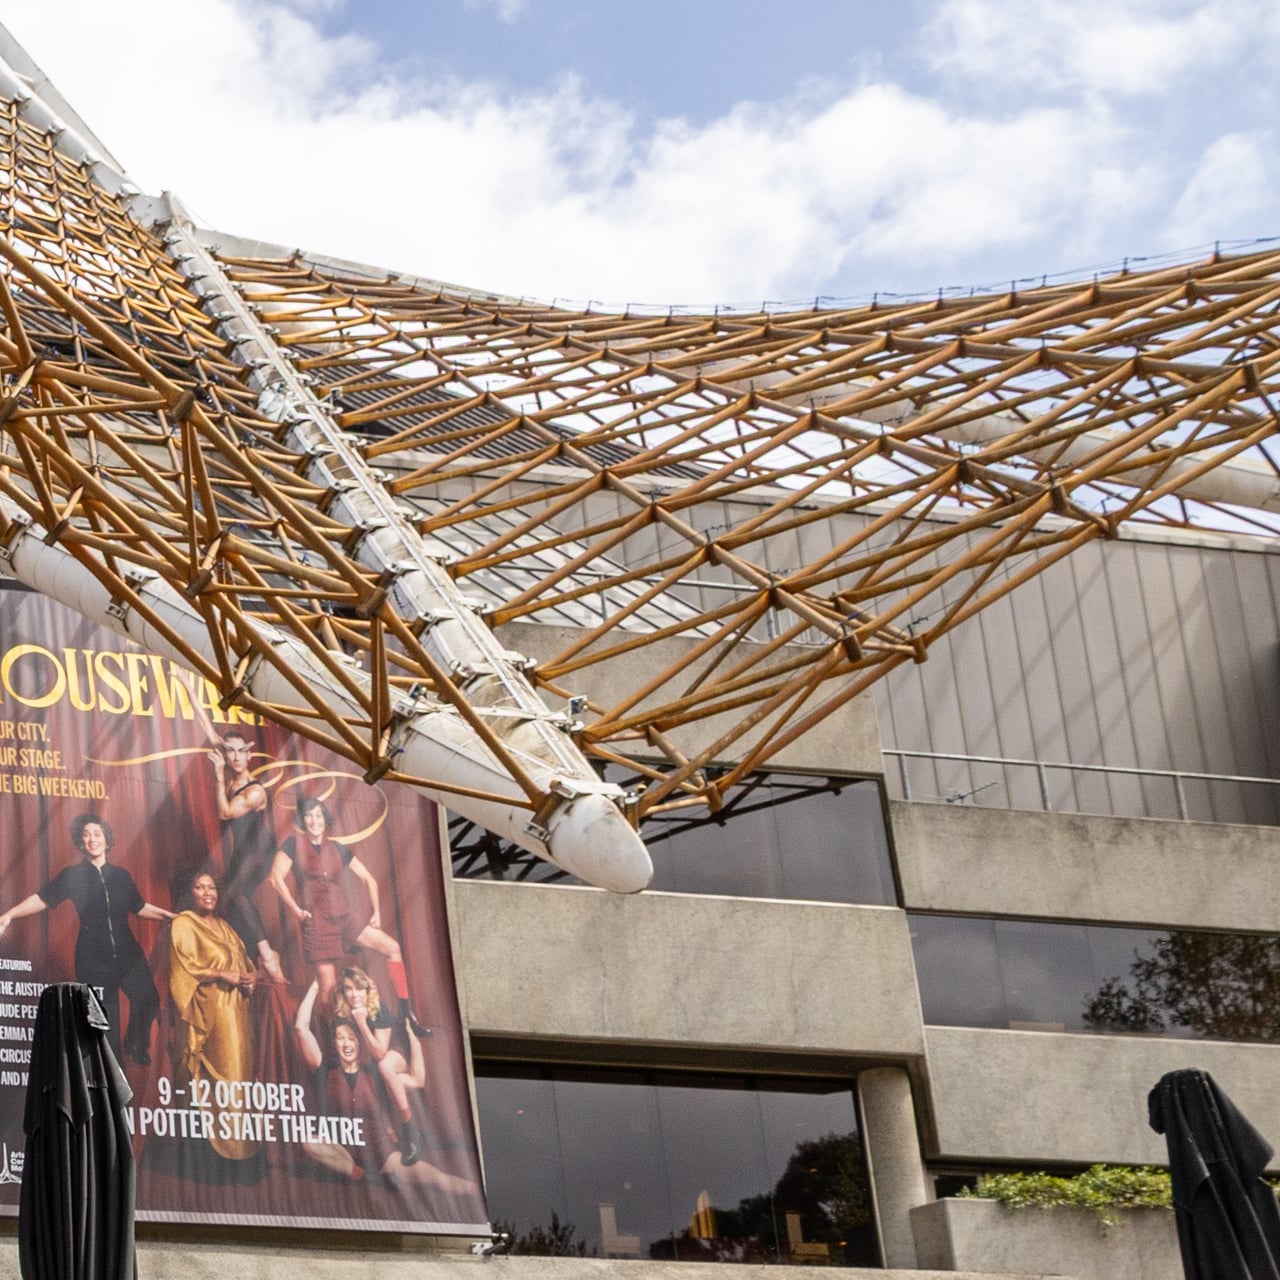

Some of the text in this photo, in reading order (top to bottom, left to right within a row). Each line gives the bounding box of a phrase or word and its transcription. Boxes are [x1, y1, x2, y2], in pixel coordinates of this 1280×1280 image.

[18, 721, 51, 743] CITY.
[20, 748, 67, 771] STAGE.
[13, 774, 38, 795] BIG
[39, 776, 110, 801] WEEKEND.
[0, 1070, 21, 1086] AND
[157, 1076, 172, 1106] 9
[188, 1078, 212, 1108] 12
[214, 1081, 306, 1113] OCTOBER
[139, 1106, 216, 1139] POTTER
[218, 1113, 277, 1142] STATE
[278, 1115, 366, 1147] THEATRE
